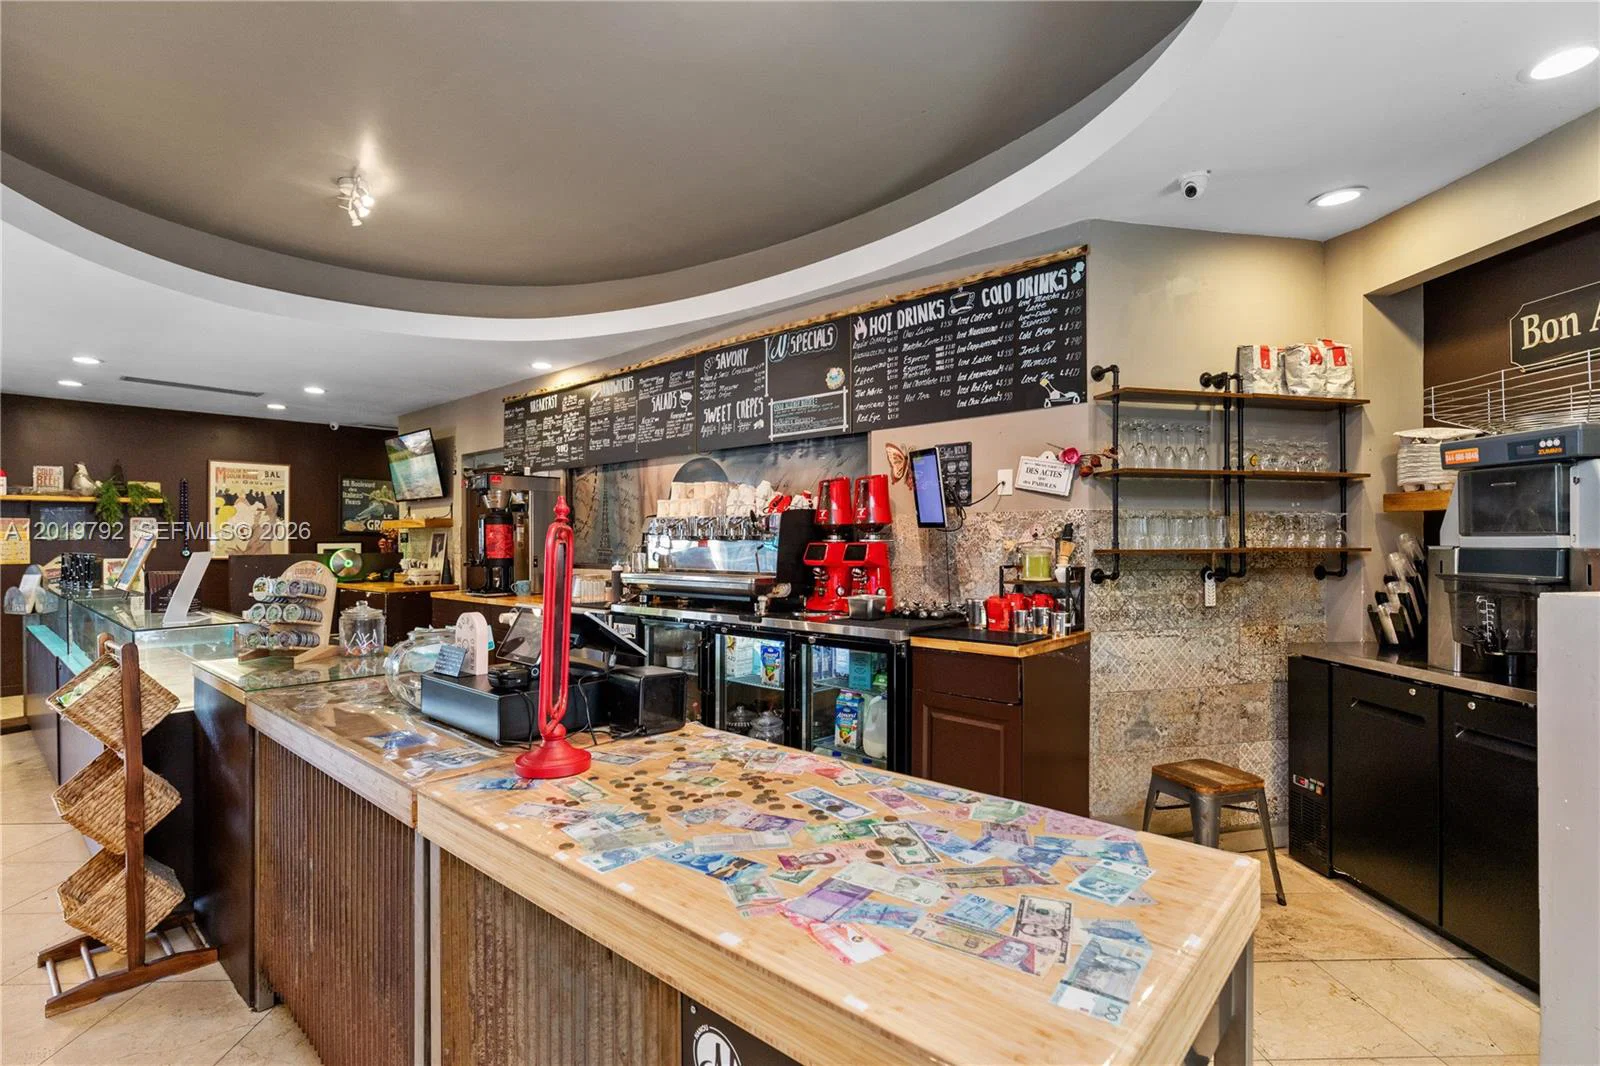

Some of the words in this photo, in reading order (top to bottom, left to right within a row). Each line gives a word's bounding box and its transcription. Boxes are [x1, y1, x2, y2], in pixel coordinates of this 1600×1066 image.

[981, 282, 1012, 307] COLD
[1015, 268, 1068, 299] DRINKS
[869, 312, 893, 337] HOT
[897, 299, 945, 330] DRINKS
[790, 326, 835, 355] SPECIALS
[1520, 312, 1582, 350] Bon
[716, 348, 749, 370] SAVORY
[529, 394, 558, 413] BREAKFAST
[651, 390, 677, 413] SALADS
[704, 402, 732, 424] SWEET
[264, 470, 281, 479] BAL
[1040, 468, 1063, 478] ACTES
